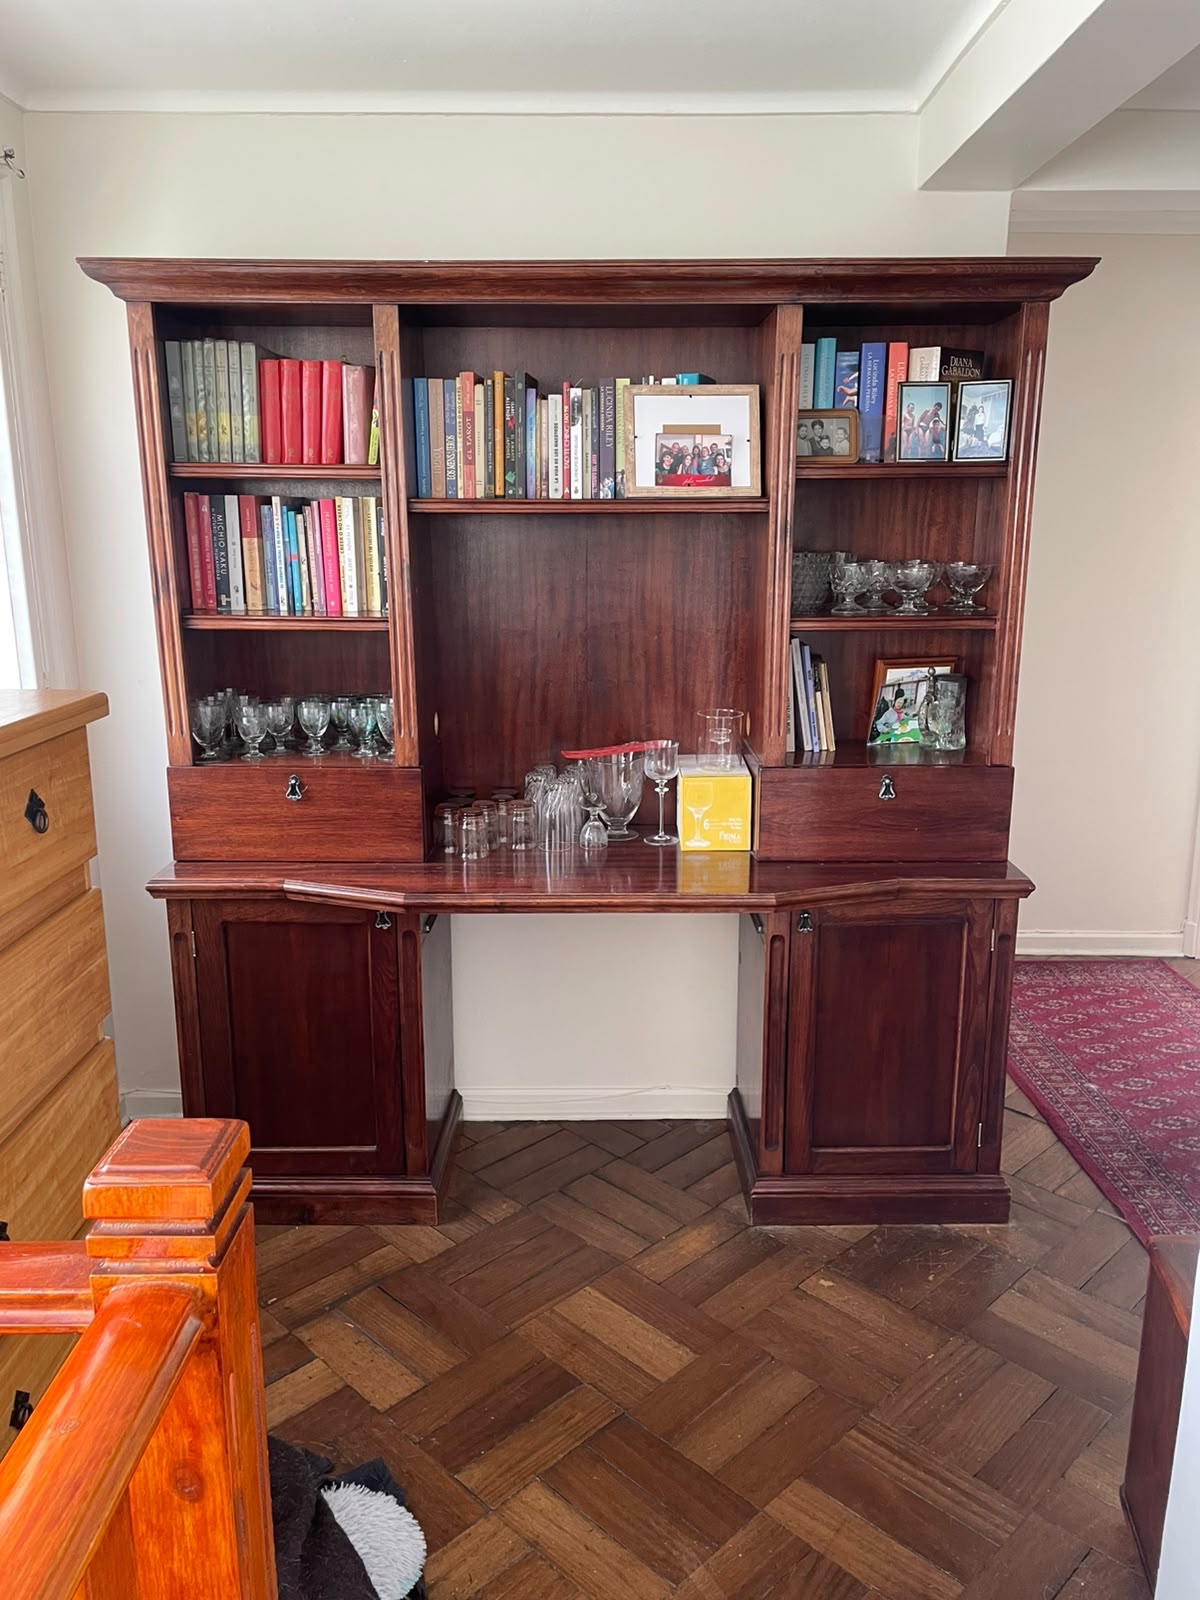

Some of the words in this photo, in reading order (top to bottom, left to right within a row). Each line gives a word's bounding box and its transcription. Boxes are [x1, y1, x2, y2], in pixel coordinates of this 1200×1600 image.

[871, 359, 880, 387] Lucinda
[941, 365, 981, 378] GABALDON
[950, 355, 973, 368] DIANA
[605, 386, 613, 423] LUCINDA
[870, 387, 878, 405] Riley
[605, 424, 613, 449] RILEY
[446, 435, 456, 469] MENSAJEROS
[447, 470, 455, 480] LOS
[216, 514, 225, 548] MICHIO
[324, 511, 333, 557] Sobrenatural
[219, 551, 227, 575] KAKU
[703, 818, 710, 831] 6
